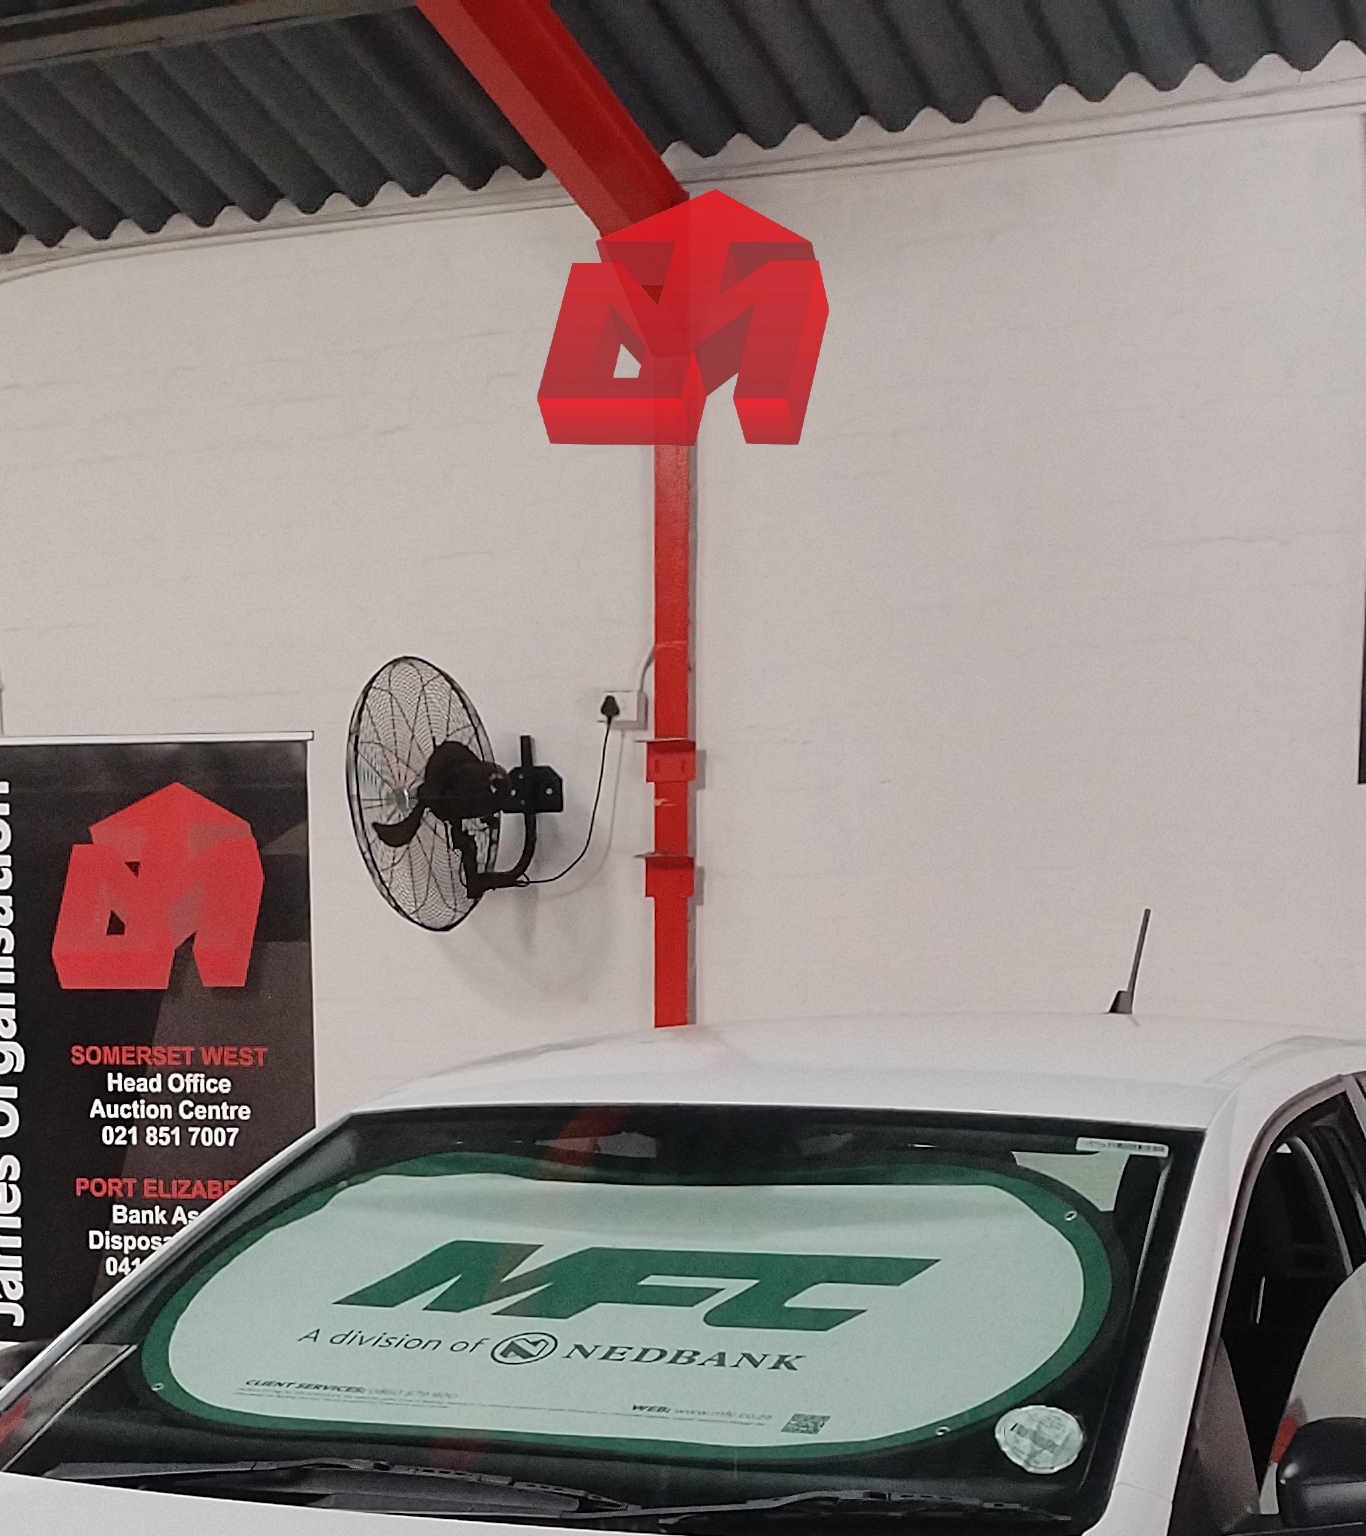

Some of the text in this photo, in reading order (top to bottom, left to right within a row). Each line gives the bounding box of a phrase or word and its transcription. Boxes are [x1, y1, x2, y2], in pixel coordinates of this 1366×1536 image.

[70, 1045, 268, 1067] SOMERSET WEST
[107, 1072, 232, 1094] Head Office
[89, 1098, 252, 1121] Auction Centre
[101, 1125, 240, 1147] 021 851 7007
[75, 1177, 137, 1198] PORT
[112, 1204, 168, 1225] Bank
[332, 1239, 942, 1332] MFC
[298, 1327, 808, 1371] A division of NEDBANK
[245, 1379, 296, 1389] CLIENT
